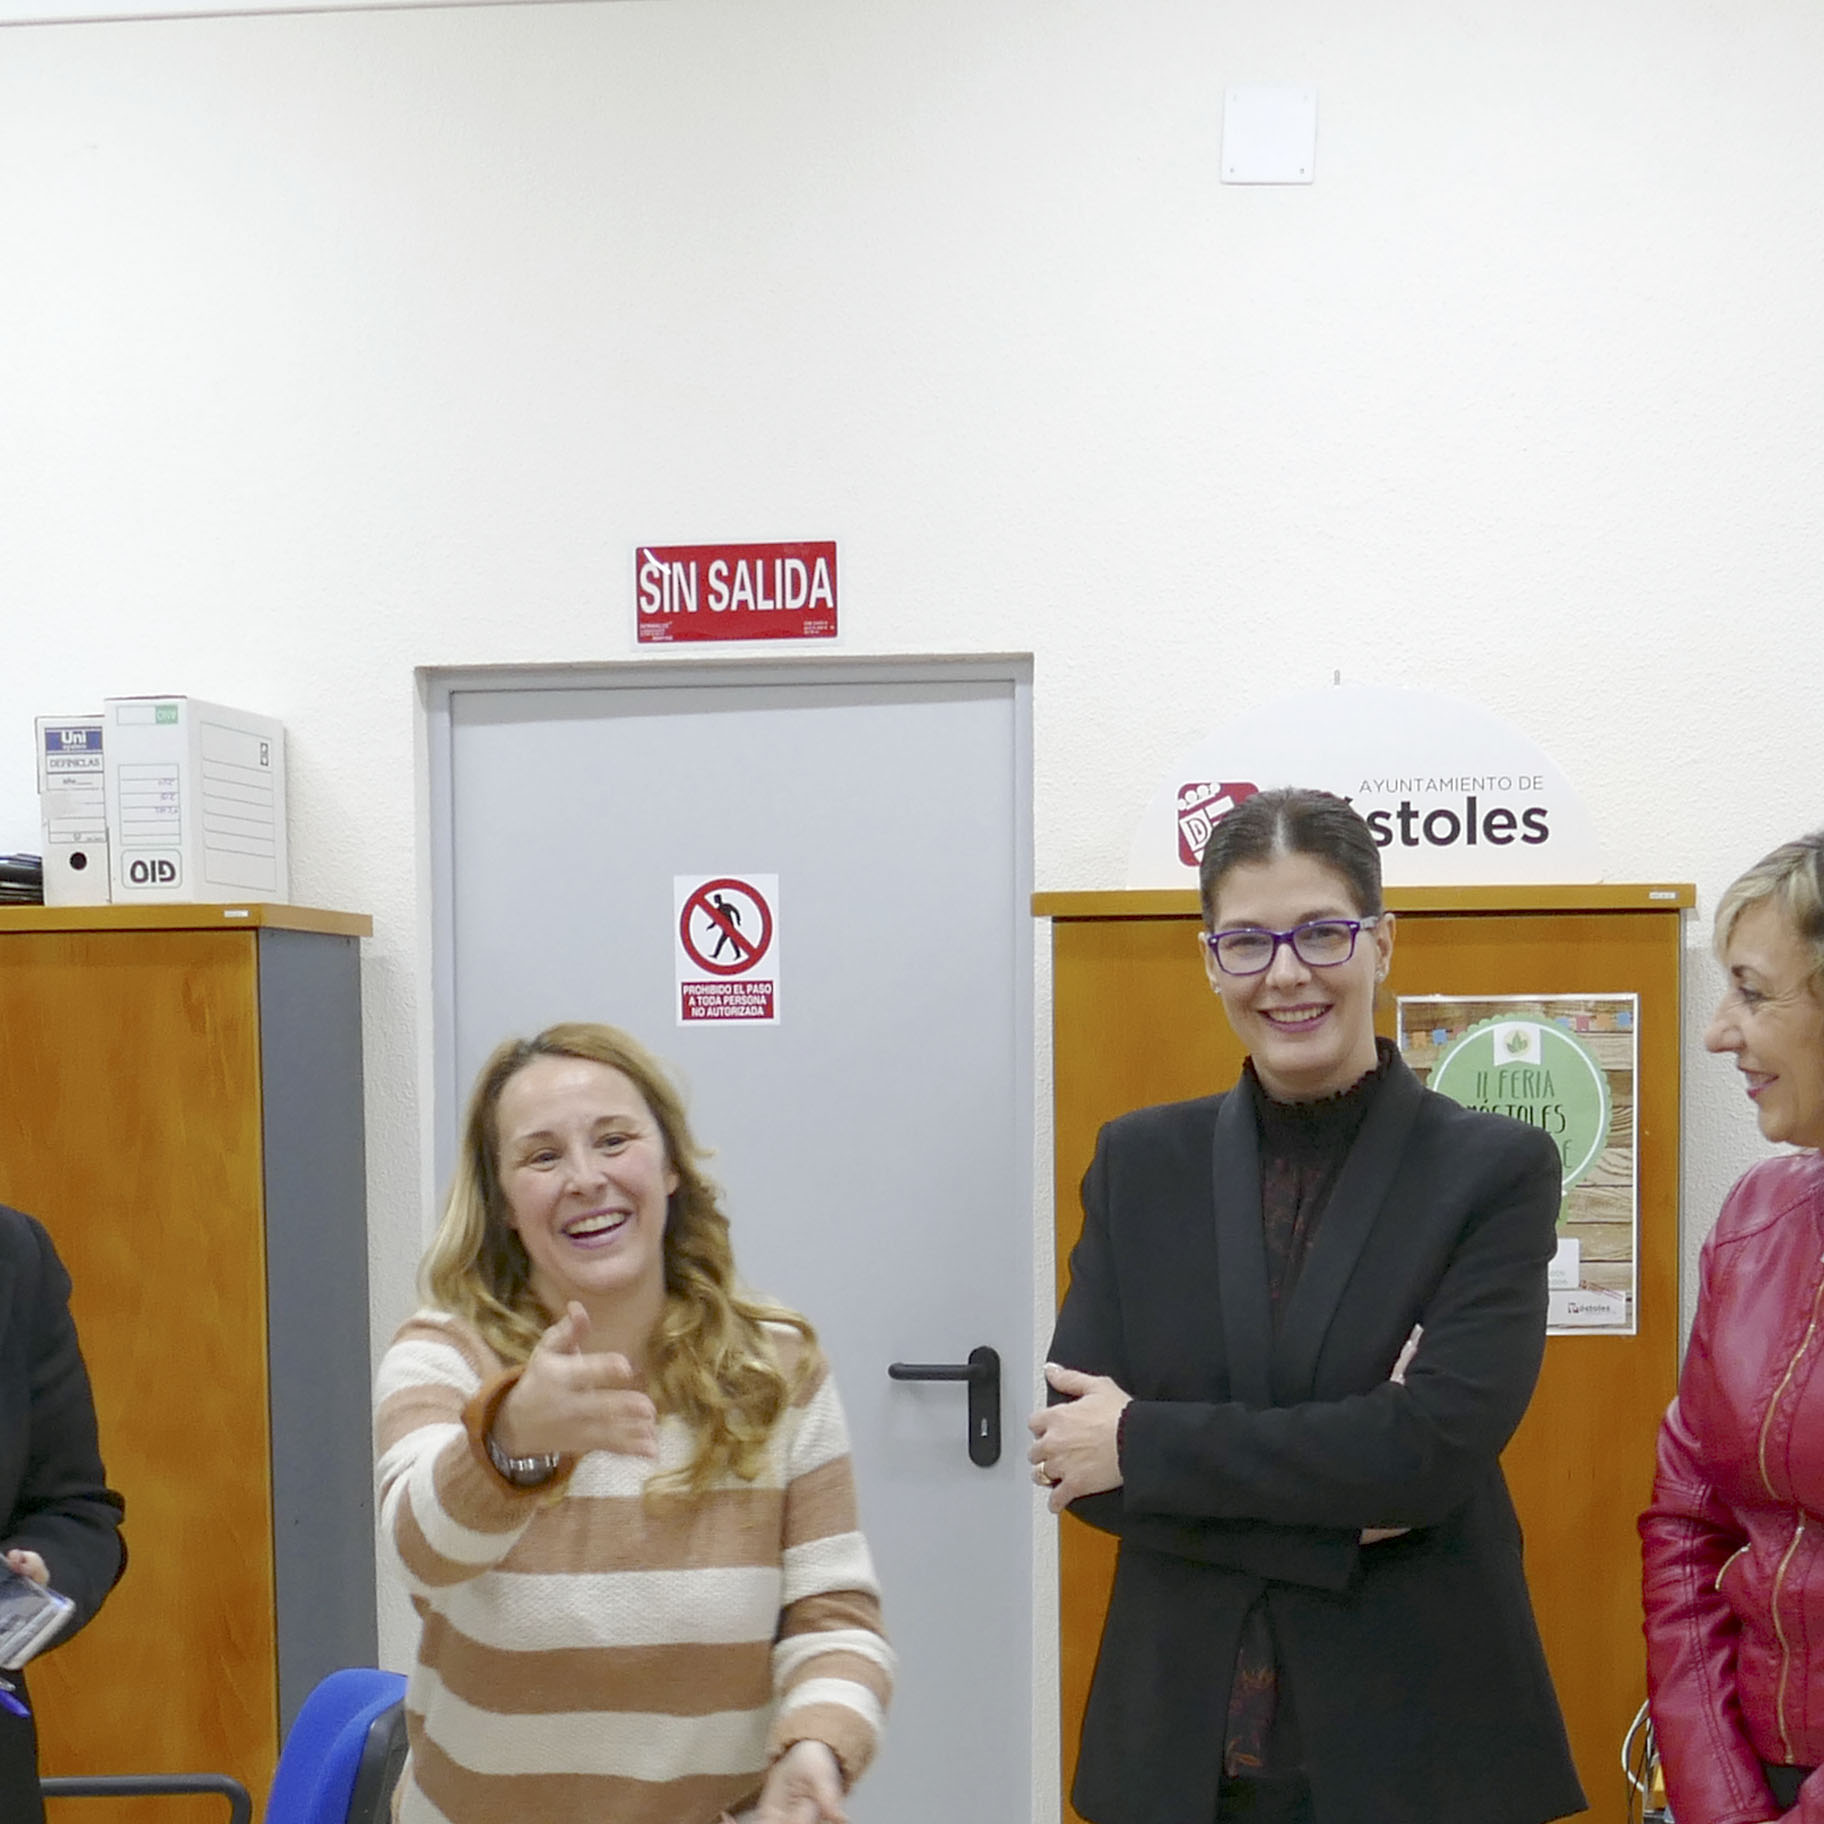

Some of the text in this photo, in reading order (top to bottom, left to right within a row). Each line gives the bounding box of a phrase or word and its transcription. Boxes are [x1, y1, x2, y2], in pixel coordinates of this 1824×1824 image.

[639, 557, 834, 614] SIN SALIDA
[1359, 775, 1544, 793] AYUNTAMIENTO DE
[1367, 796, 1550, 848] stoles
[129, 860, 177, 883] GIO
[683, 983, 772, 995] PROHIBIDO EL PASO
[688, 994, 767, 1006] A TODA PERSONA
[691, 1005, 764, 1017] NO AUTORIZADA
[1498, 1069, 1555, 1099] FERIA
